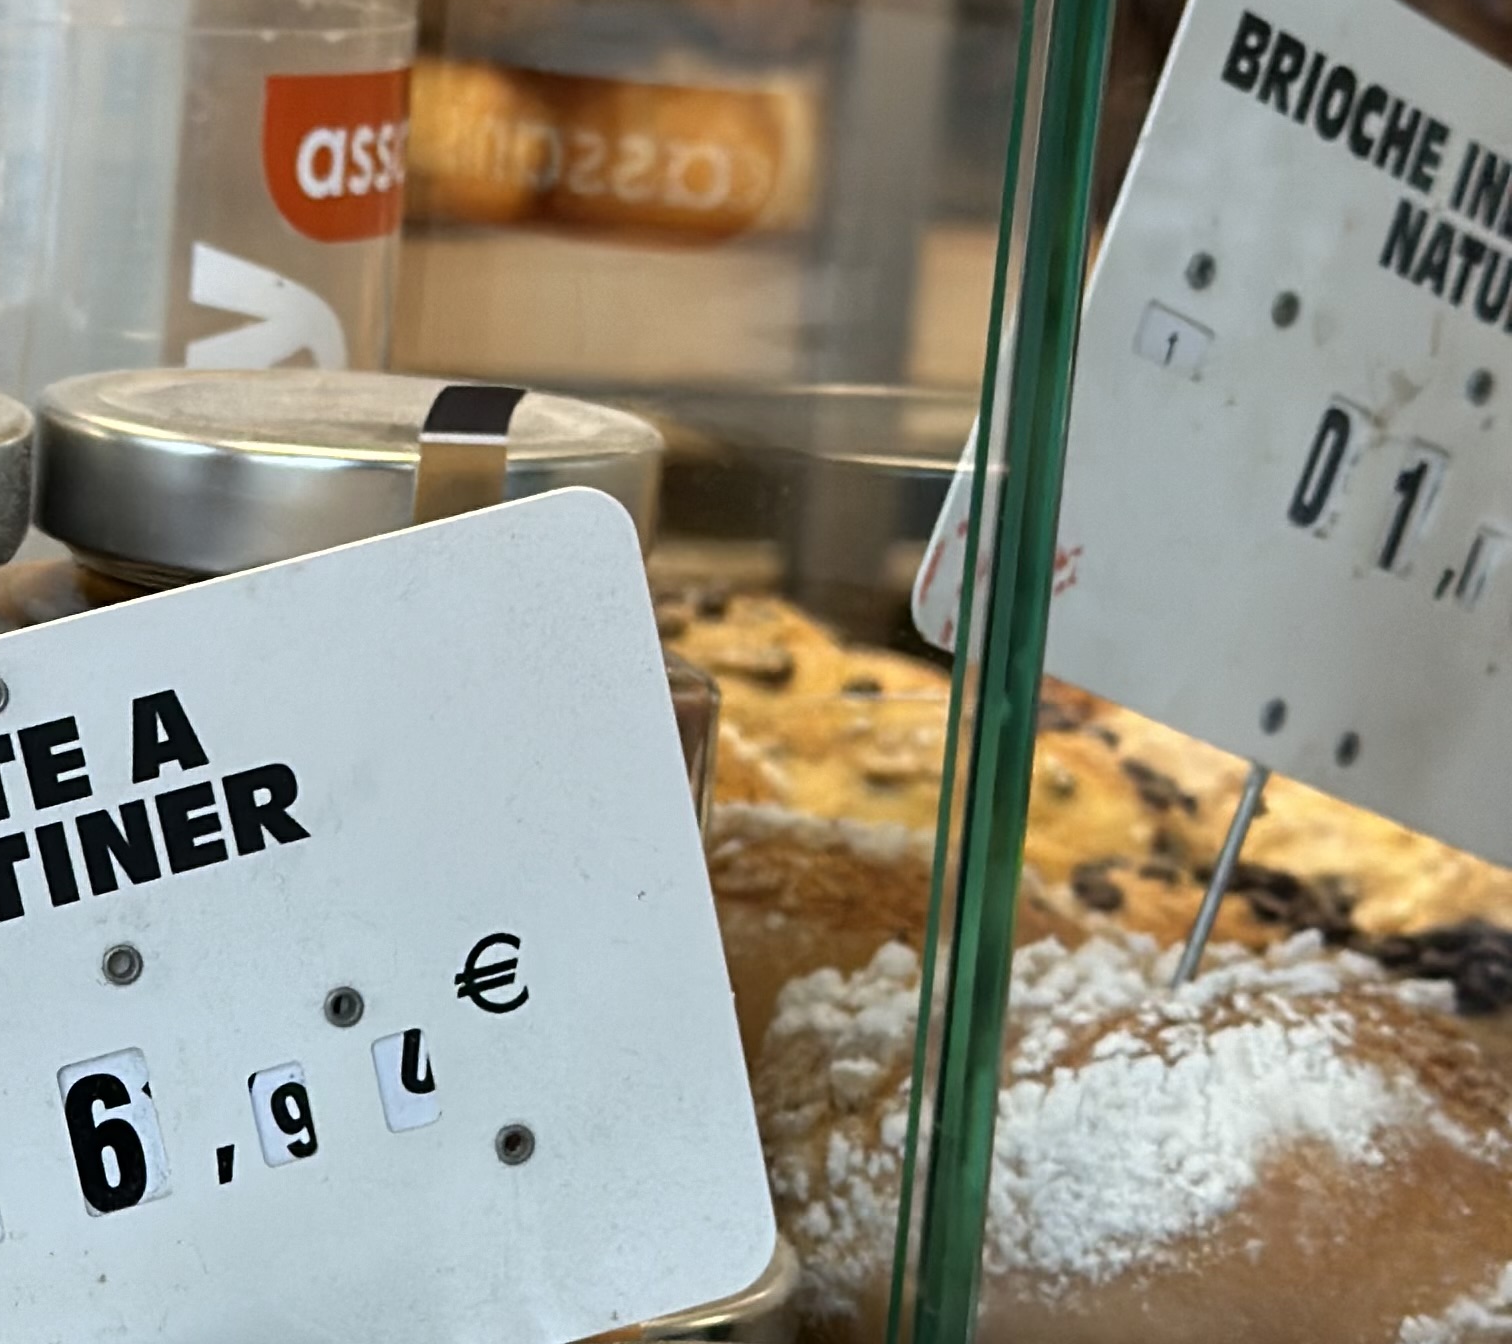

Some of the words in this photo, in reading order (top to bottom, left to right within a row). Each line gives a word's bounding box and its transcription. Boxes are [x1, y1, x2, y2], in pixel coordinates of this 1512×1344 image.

[1221, 9, 1450, 195] BRIOCHE
[1450, 139, 1512, 244] IN
[1378, 196, 1512, 338] NATU
[131, 689, 210, 784] A
[453, 931, 530, 1014] €
